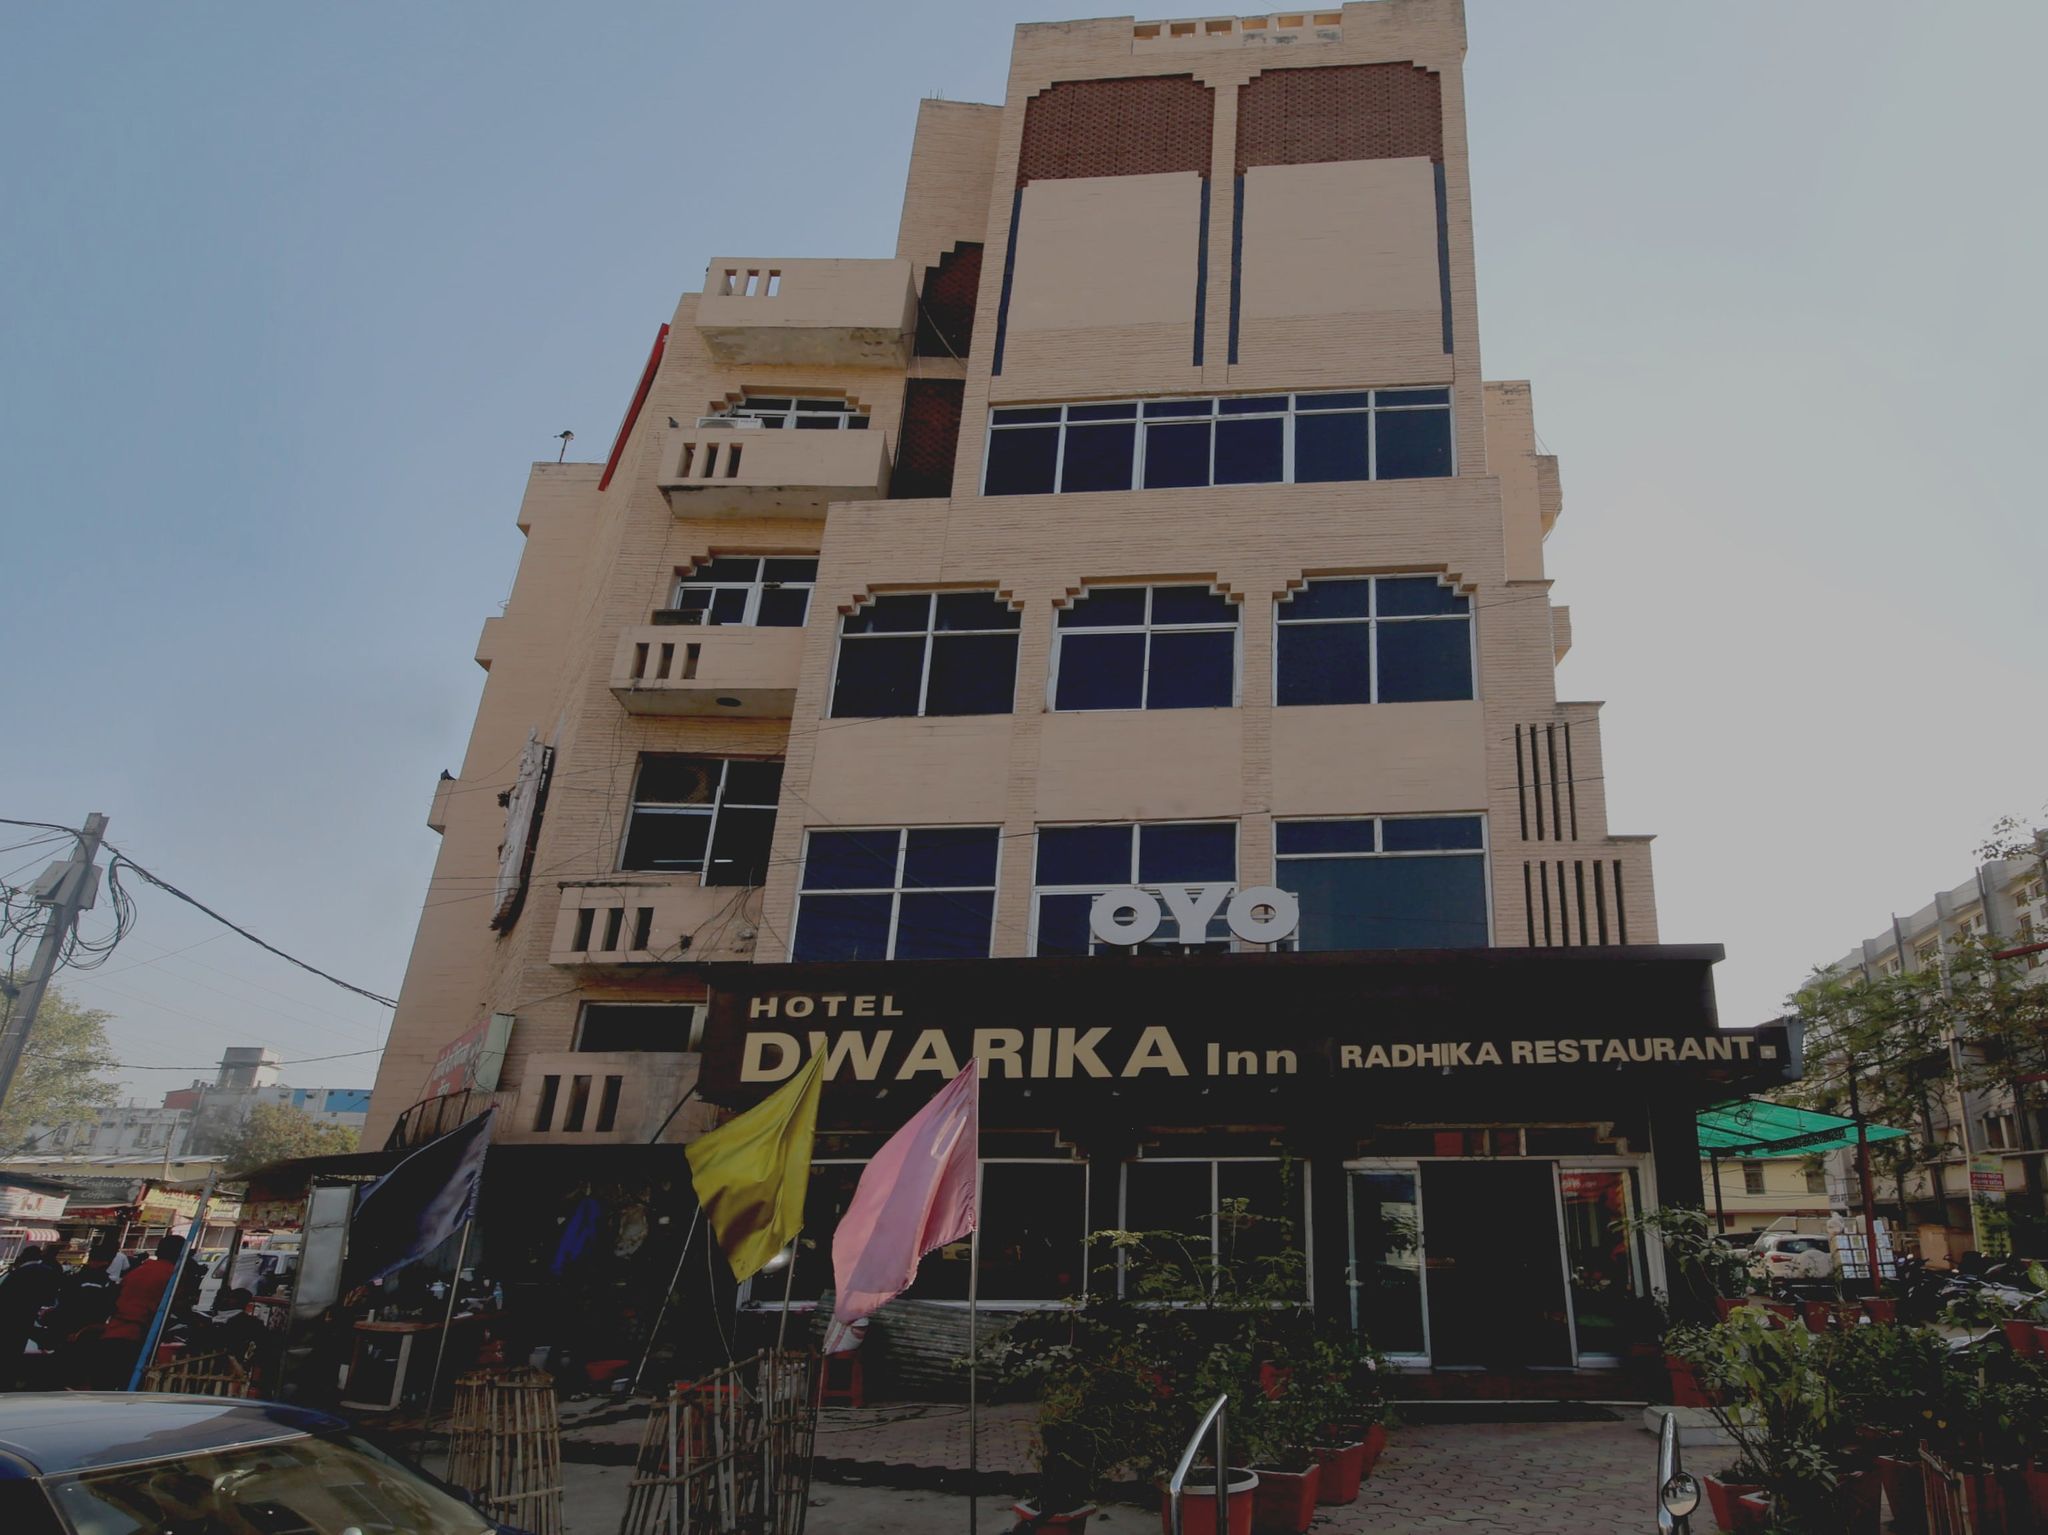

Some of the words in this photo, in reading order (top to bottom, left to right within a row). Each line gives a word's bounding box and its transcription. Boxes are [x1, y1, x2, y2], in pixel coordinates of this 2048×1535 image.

[1090, 886, 1300, 947] OYO
[749, 995, 903, 1018] HOTEL
[740, 1026, 1190, 1083] DWARIKA
[1207, 1042, 1297, 1076] Inn
[1341, 1042, 1503, 1069] RADHIKA
